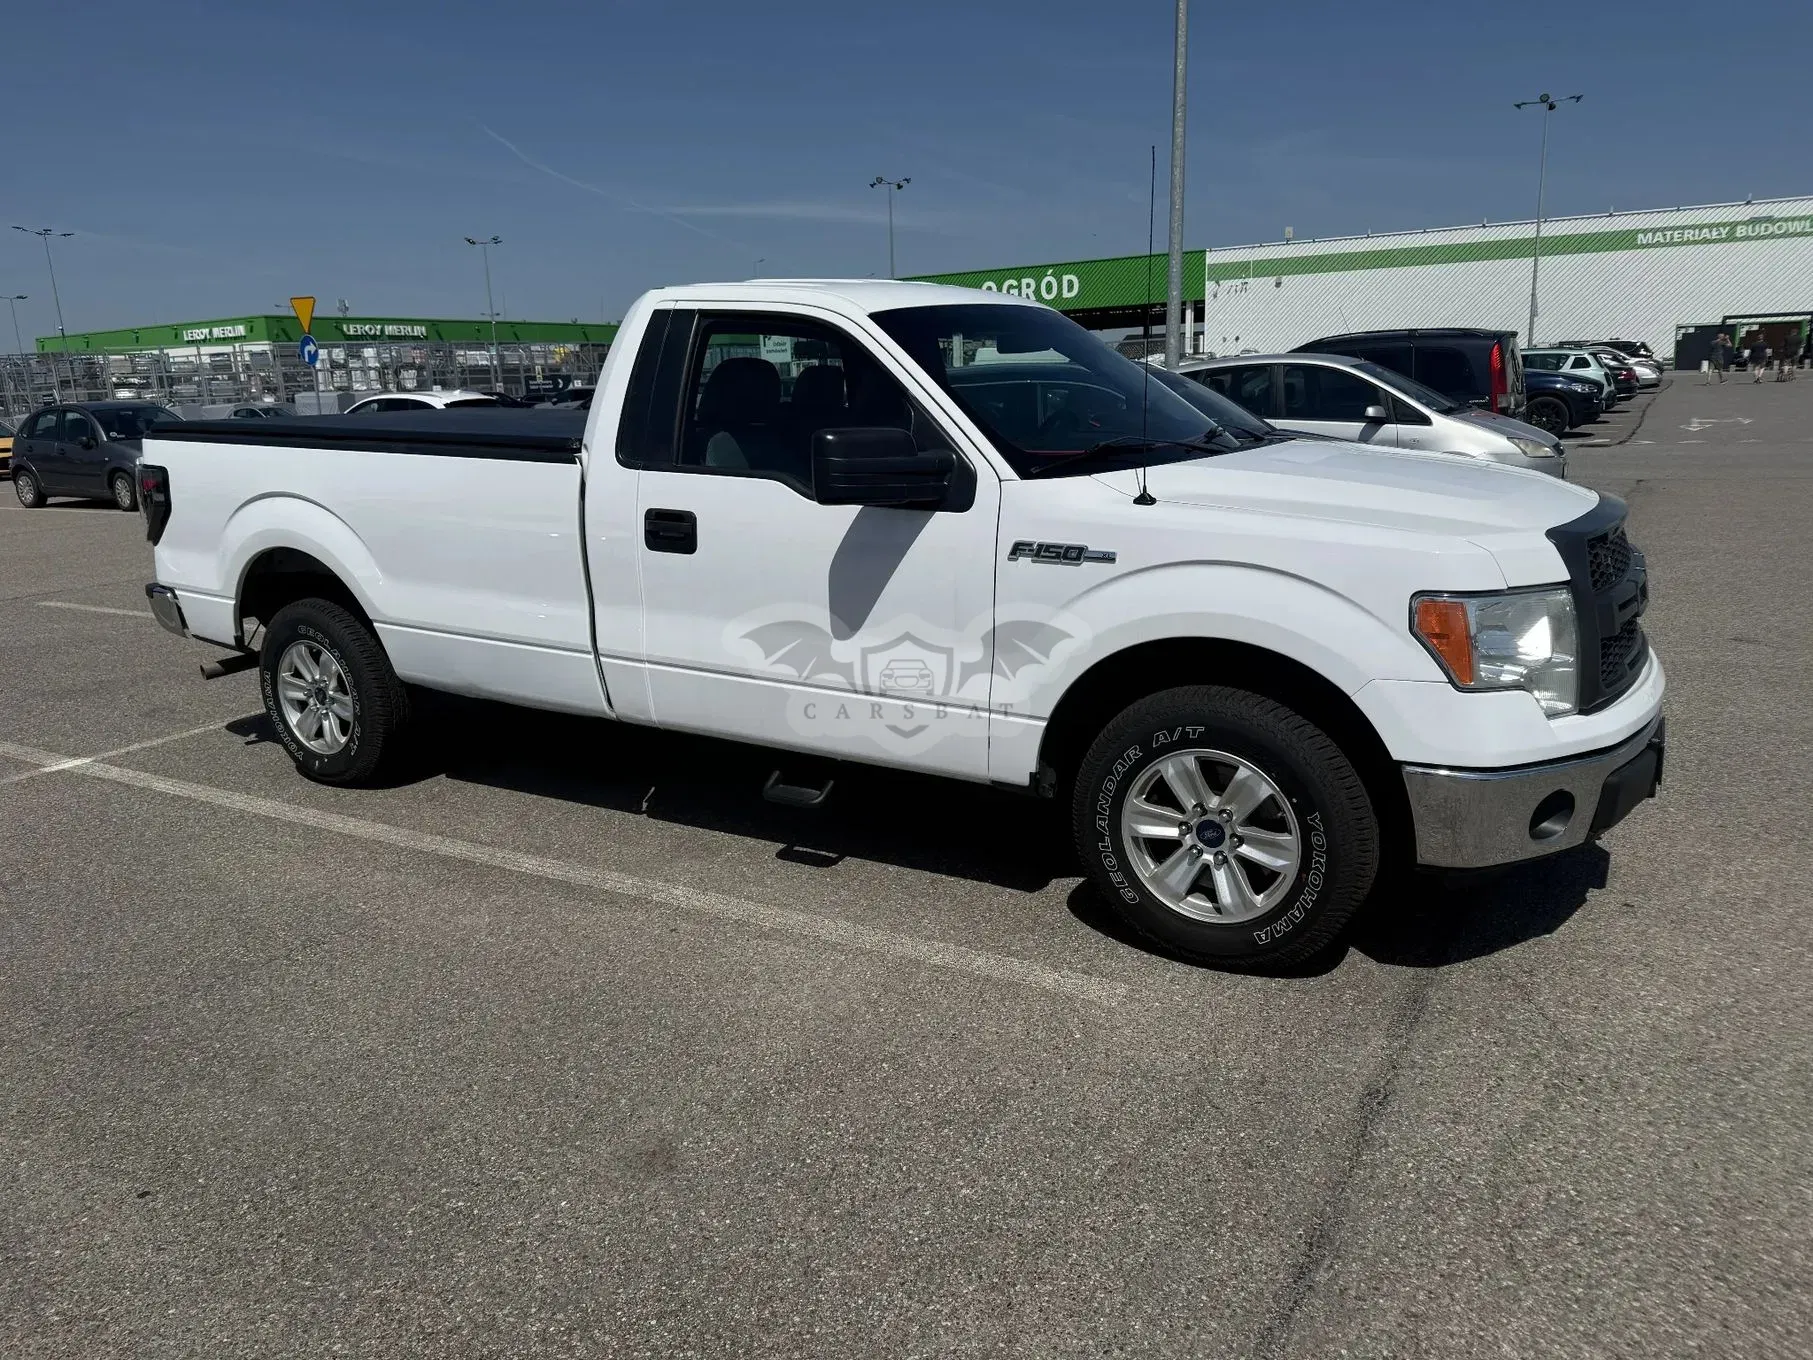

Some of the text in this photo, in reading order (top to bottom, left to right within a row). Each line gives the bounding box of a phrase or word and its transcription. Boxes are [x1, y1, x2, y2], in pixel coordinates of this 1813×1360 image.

[1637, 227, 1730, 245] MATERIAŁY
[183, 326, 246, 341] LEROY MERLIN
[344, 324, 426, 337] LEROY MERLIN
[1095, 726, 1206, 904] GEOLANDAR A/T
[1254, 812, 1327, 945] YOKOHAMA
